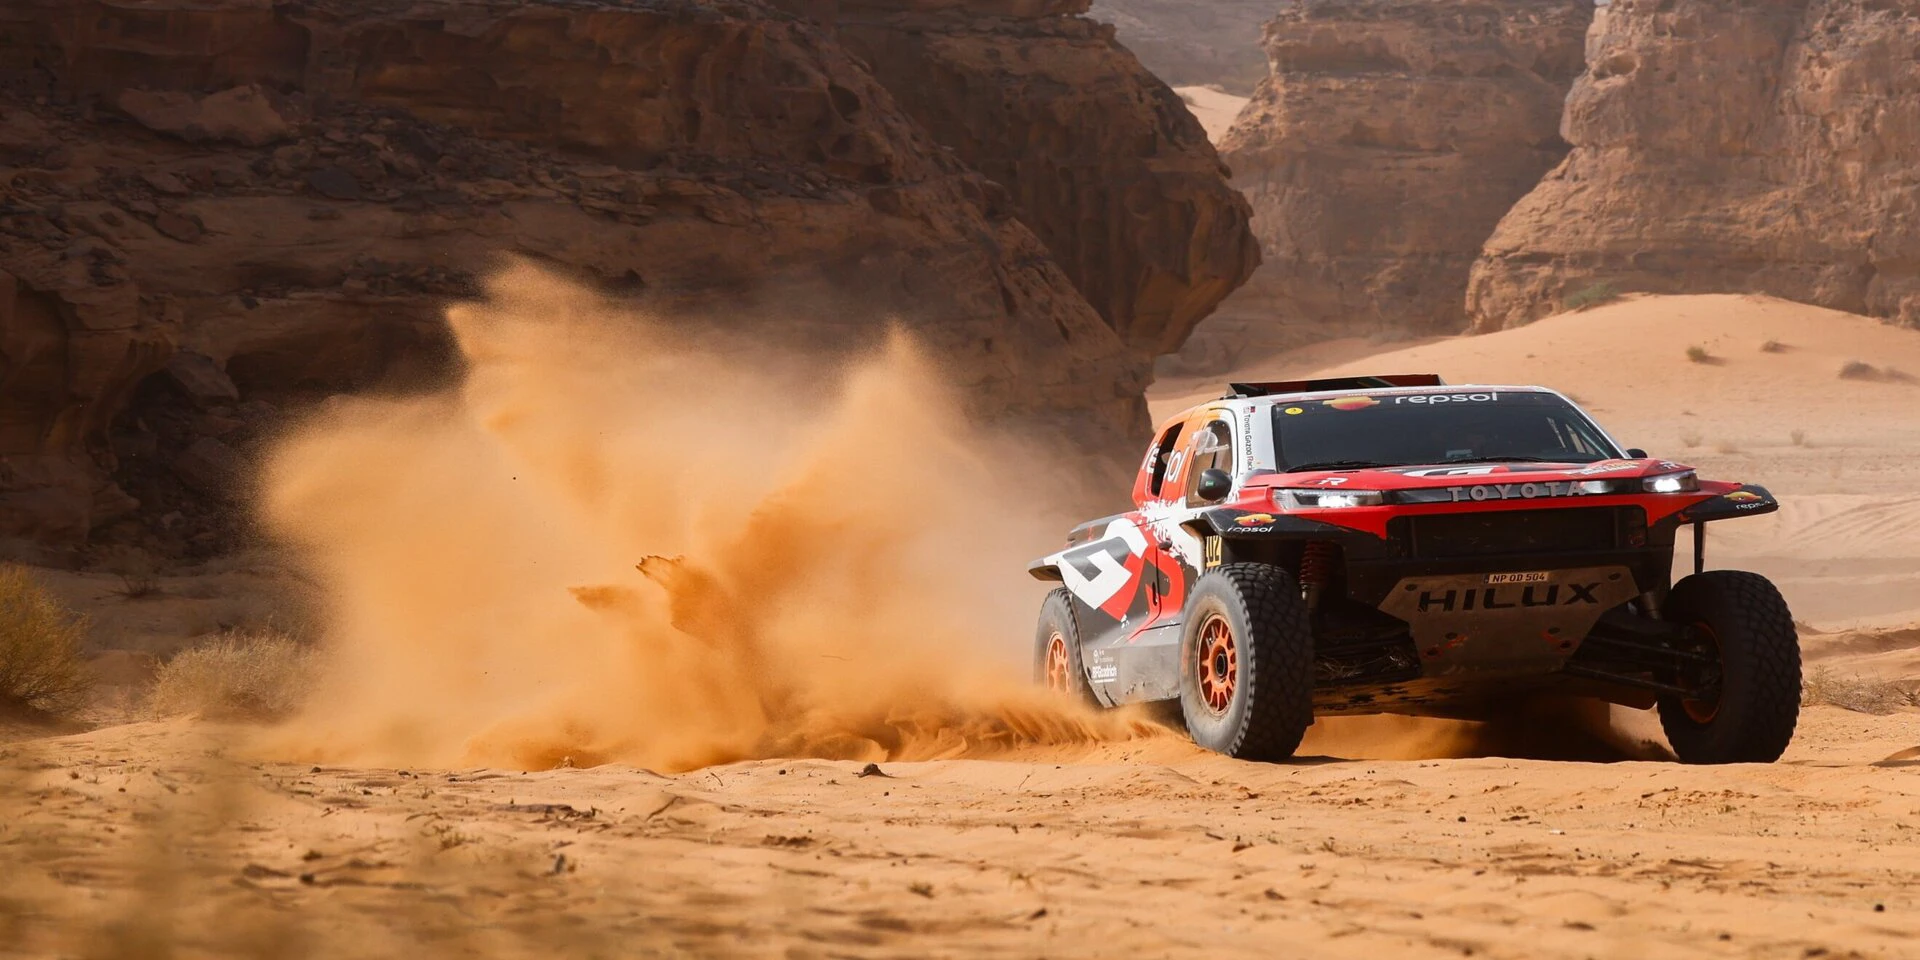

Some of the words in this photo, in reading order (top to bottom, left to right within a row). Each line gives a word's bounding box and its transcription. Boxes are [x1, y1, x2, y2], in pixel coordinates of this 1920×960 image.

[1395, 392, 1497, 404] repsol
[1243, 414, 1251, 435] TOYOTA
[1245, 434, 1253, 456] GAZOO
[1447, 480, 1586, 502] TOYOTA
[1227, 525, 1274, 534] repsol
[1492, 574, 1507, 582] NP
[1525, 572, 1545, 581] 504
[1417, 582, 1602, 613] HILUX
